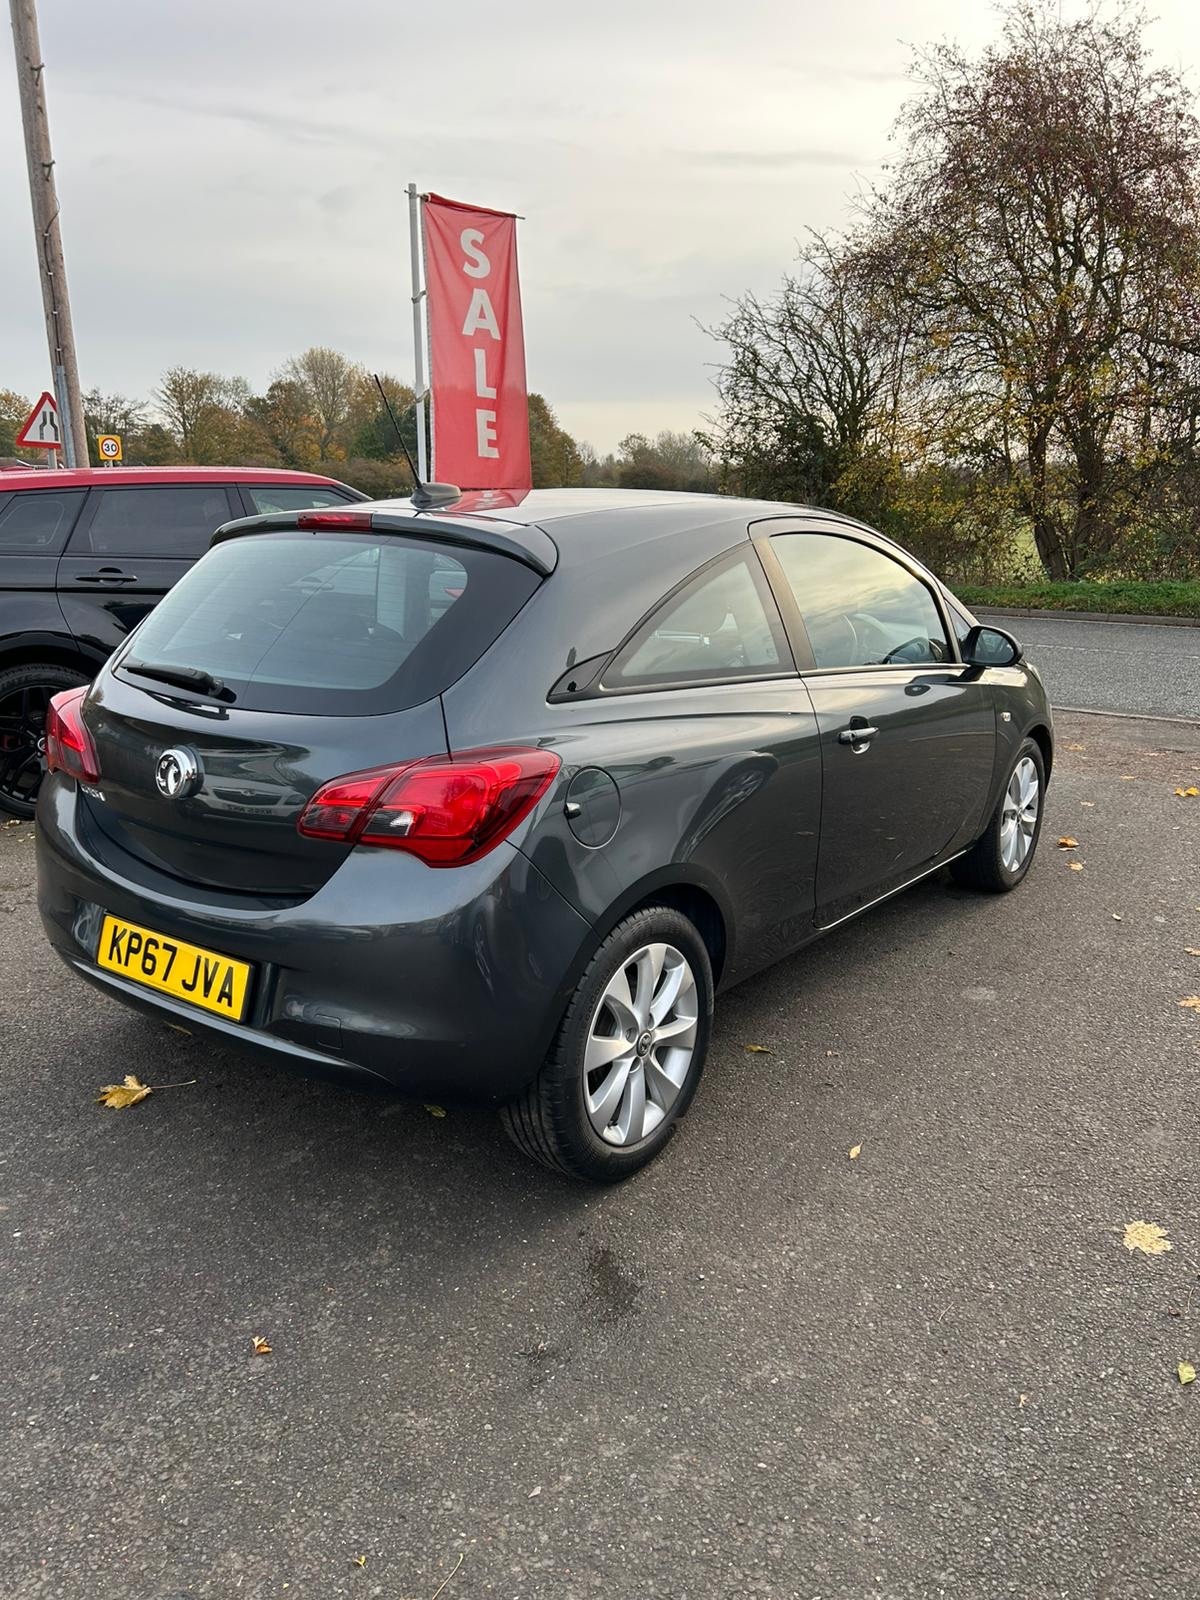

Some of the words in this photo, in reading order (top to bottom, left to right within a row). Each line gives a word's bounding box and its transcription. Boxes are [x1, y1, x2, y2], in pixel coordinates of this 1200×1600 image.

[460, 228, 501, 459] SALE
[104, 443, 117, 452] 30
[108, 924, 178, 982] KP67
[181, 955, 233, 1008] JVA
